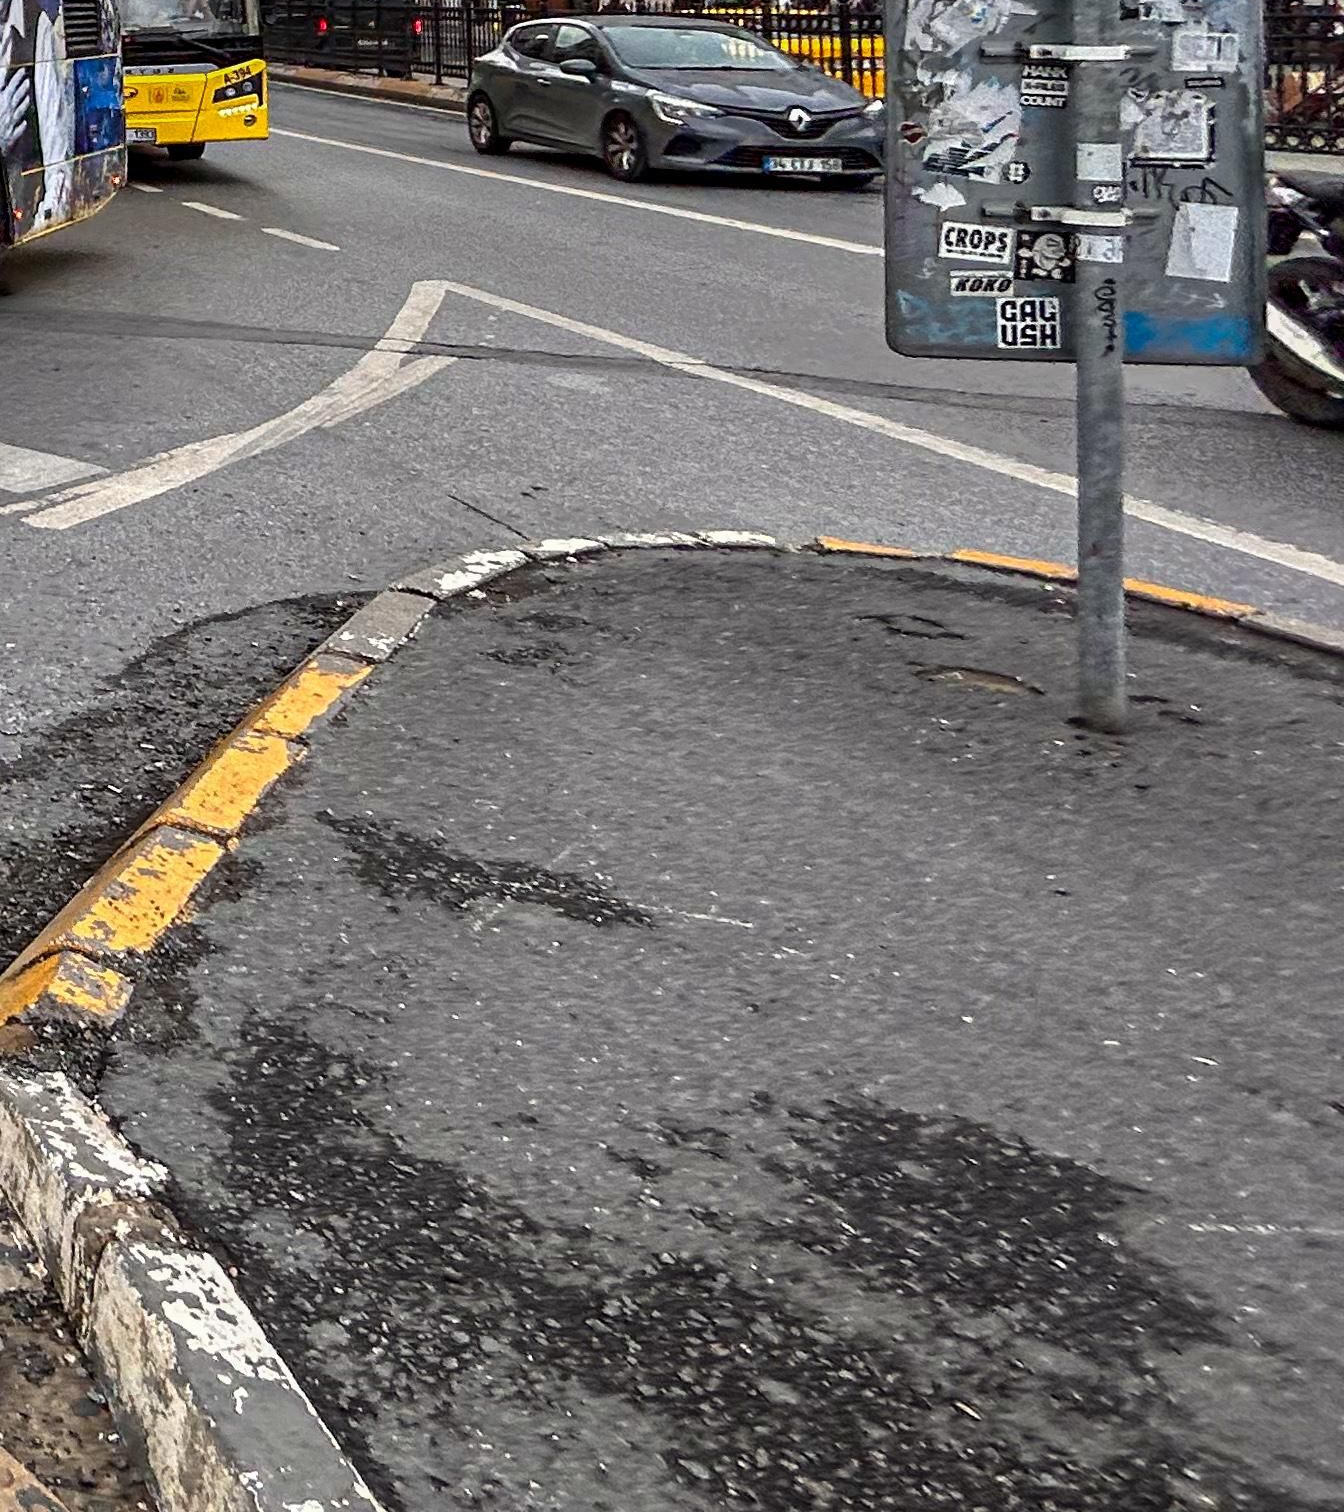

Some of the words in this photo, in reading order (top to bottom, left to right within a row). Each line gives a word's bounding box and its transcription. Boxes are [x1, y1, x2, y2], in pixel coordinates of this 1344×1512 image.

[1021, 95, 1066, 108] COUNT
[944, 226, 1009, 253] CROPS
[955, 277, 1012, 293] KOKO
[1000, 324, 1058, 347] USH
